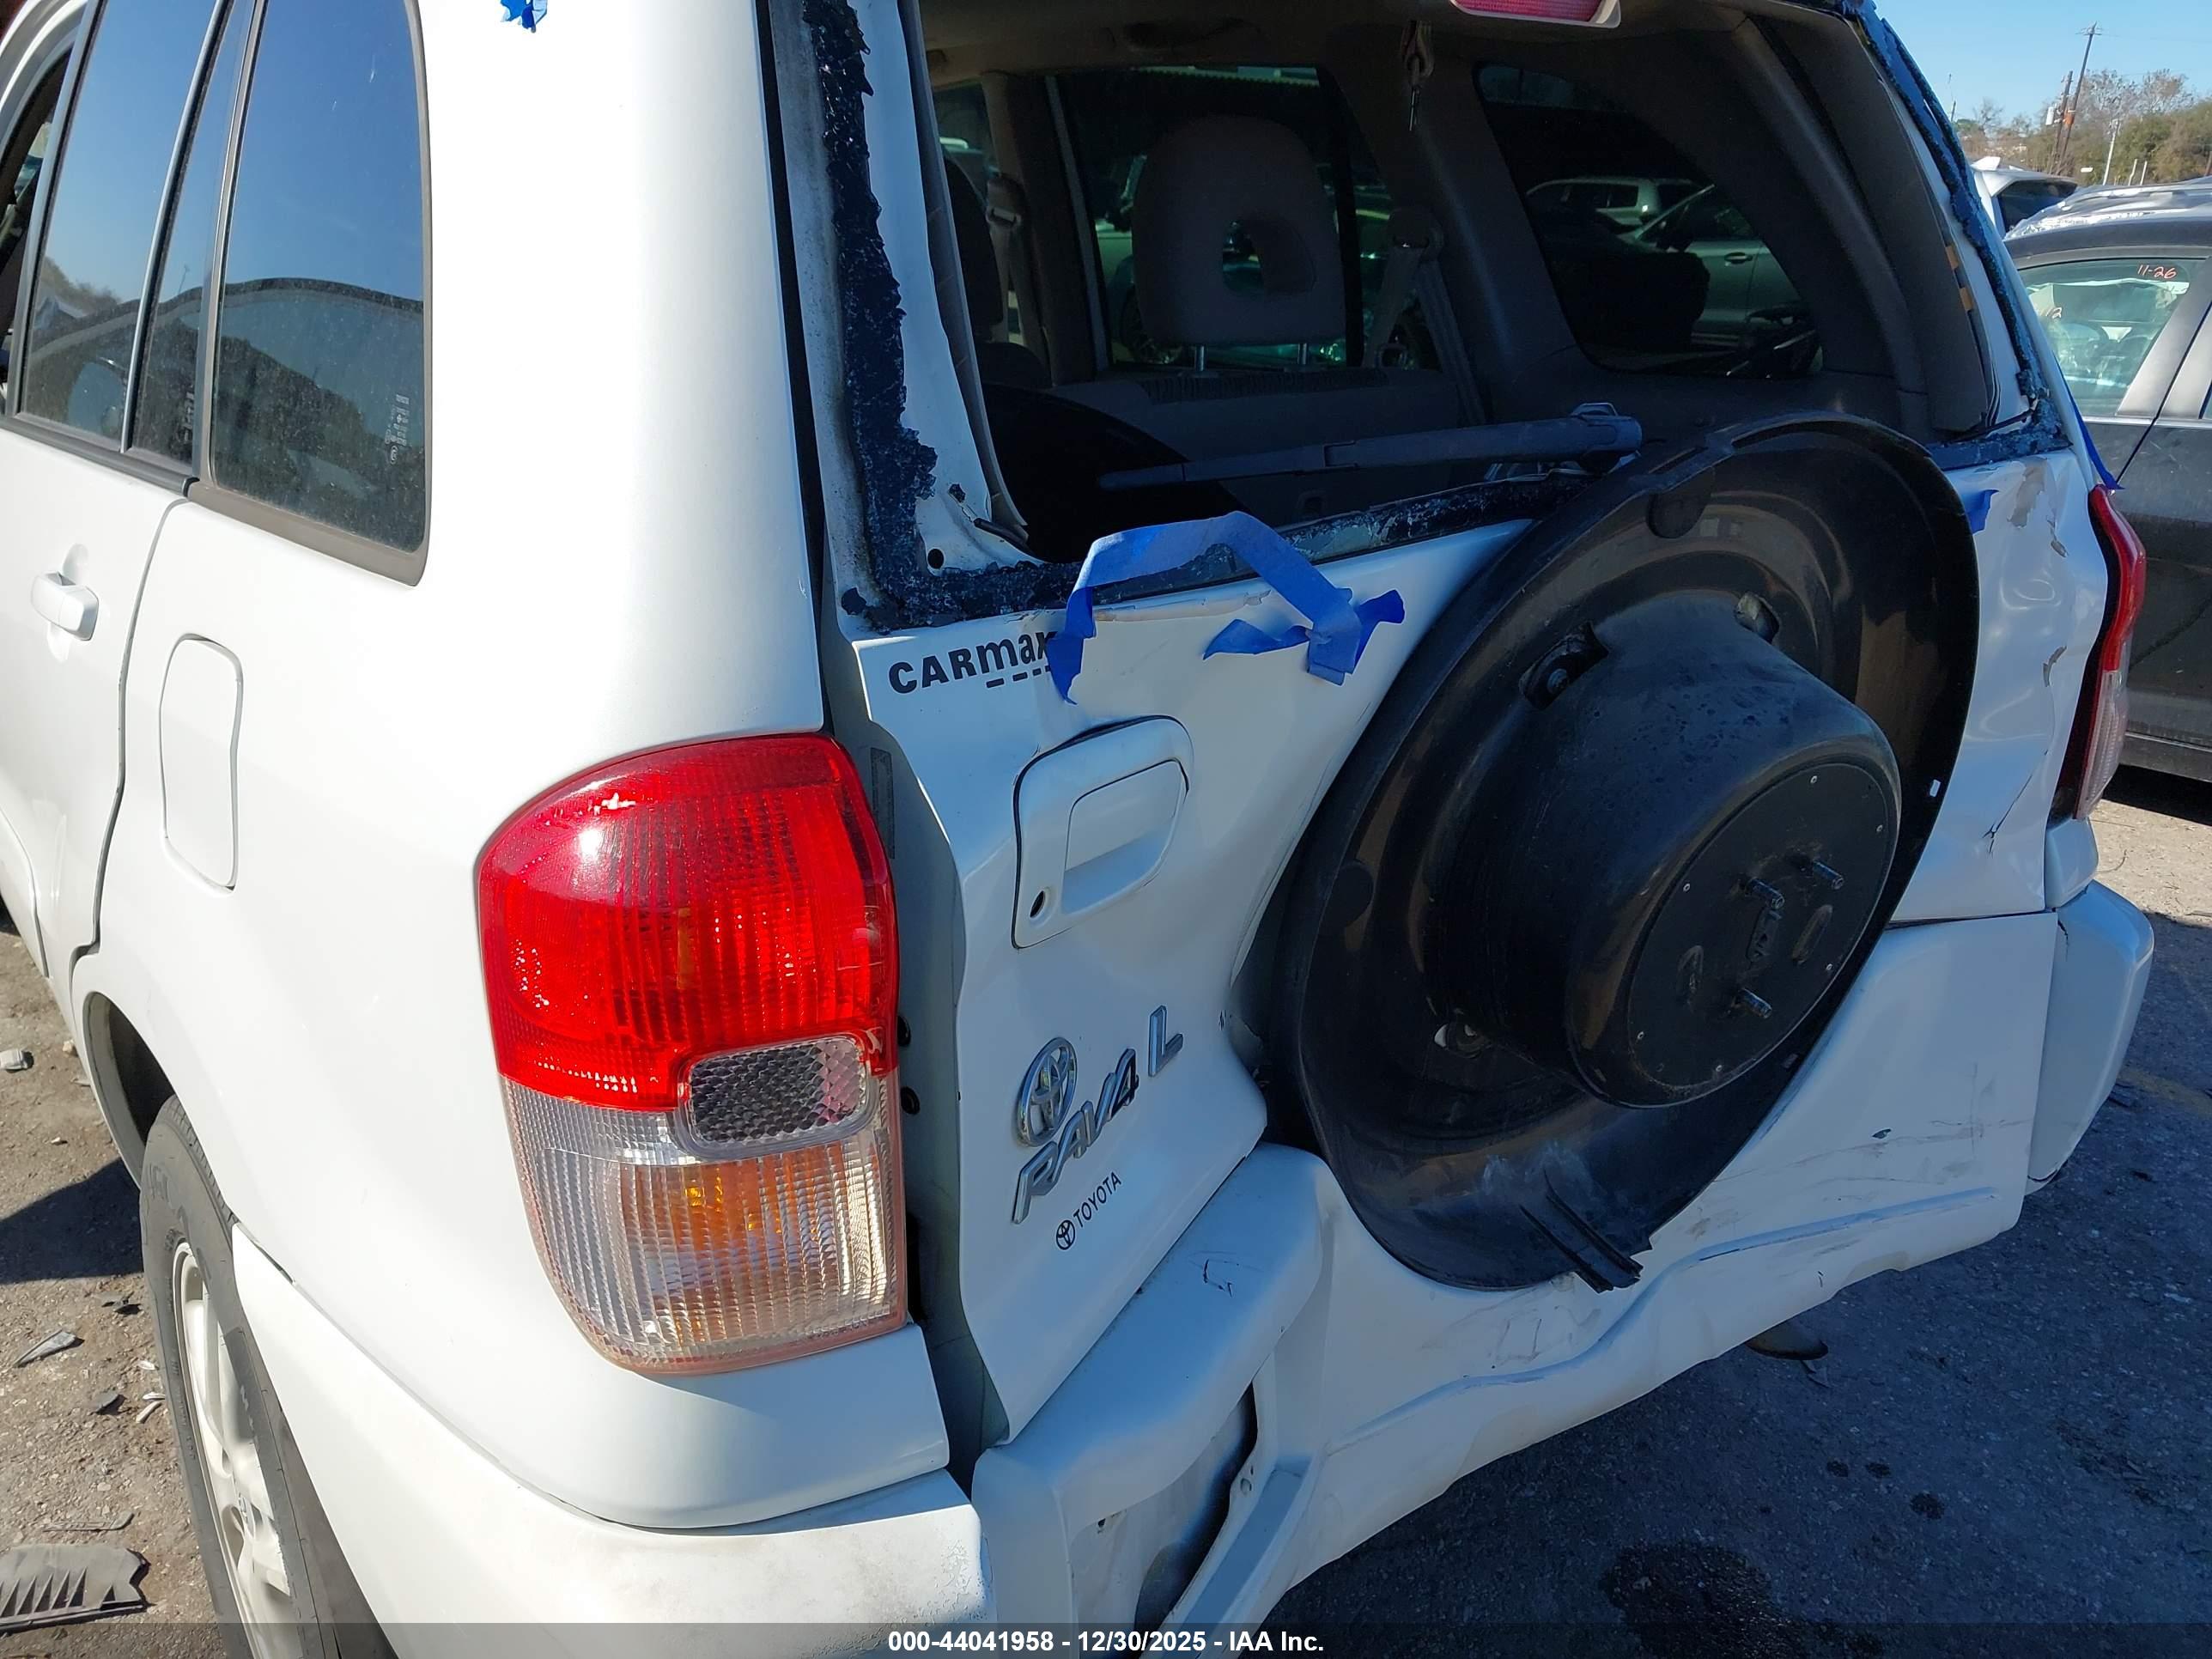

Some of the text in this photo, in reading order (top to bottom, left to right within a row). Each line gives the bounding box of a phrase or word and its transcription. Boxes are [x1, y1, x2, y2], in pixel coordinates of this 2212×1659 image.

[2137, 264, 2177, 279] 11-26
[1148, 1005, 1183, 1078] L
[1073, 1171, 1122, 1228] TOYOTA
